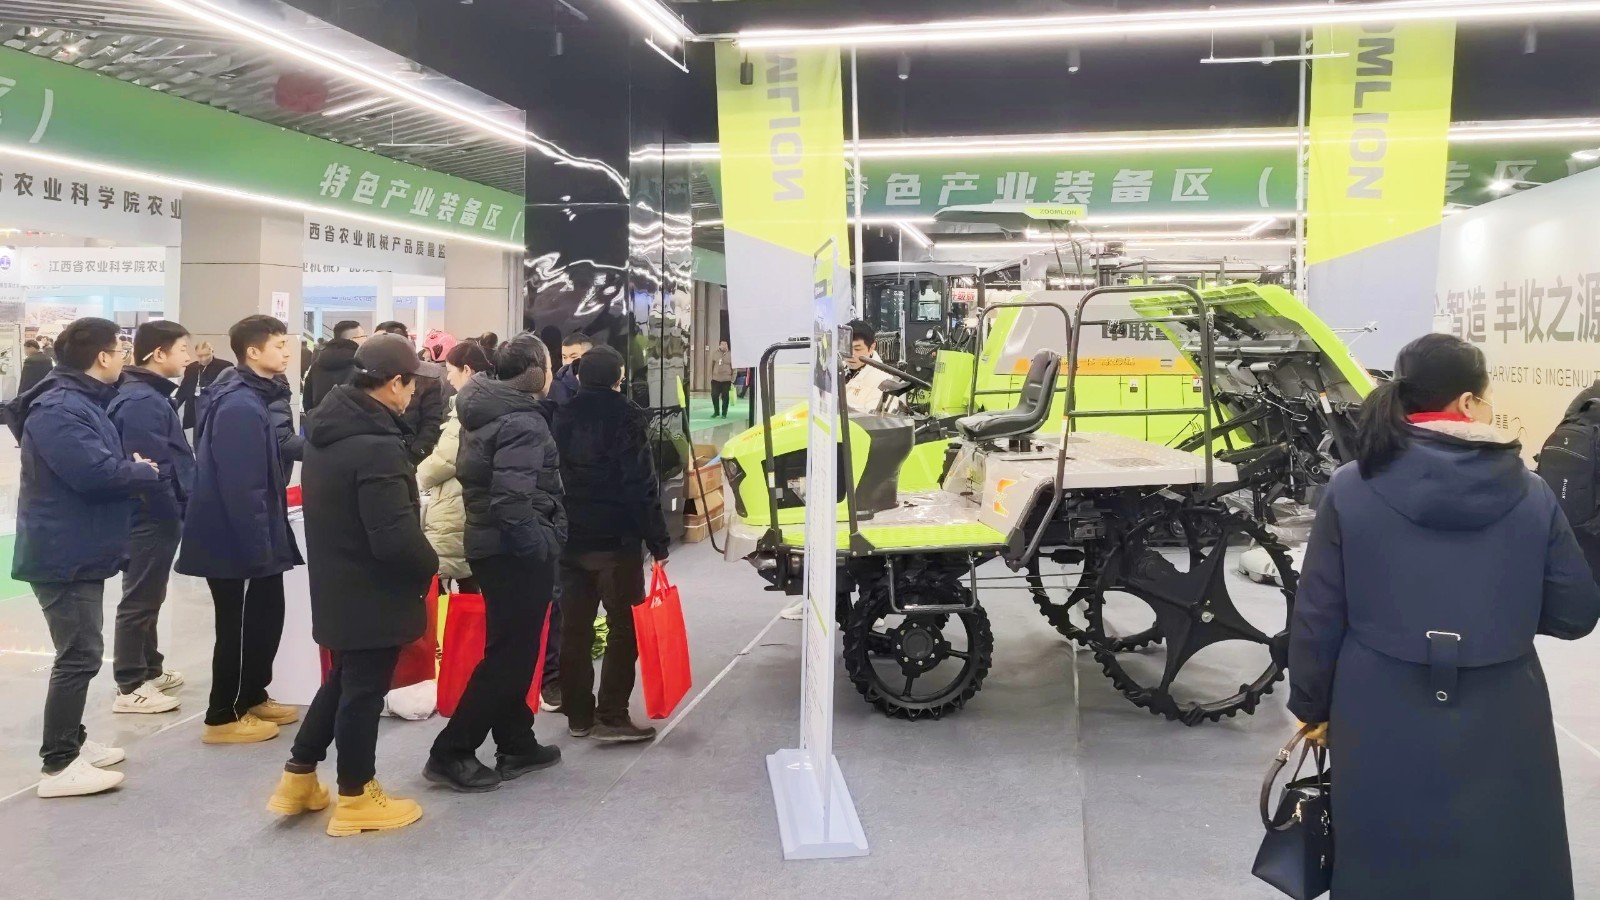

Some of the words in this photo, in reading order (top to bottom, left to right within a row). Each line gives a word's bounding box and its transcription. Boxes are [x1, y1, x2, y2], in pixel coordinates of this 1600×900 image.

[0, 172, 181, 219] 农业科学院农业
[847, 167, 1308, 208] 色产业装备区（
[309, 222, 446, 259] 西省农业机械产品质量监
[1433, 285, 1486, 342] 智造
[1494, 271, 1600, 344] 丰收之源
[1532, 367, 1542, 385] IS
